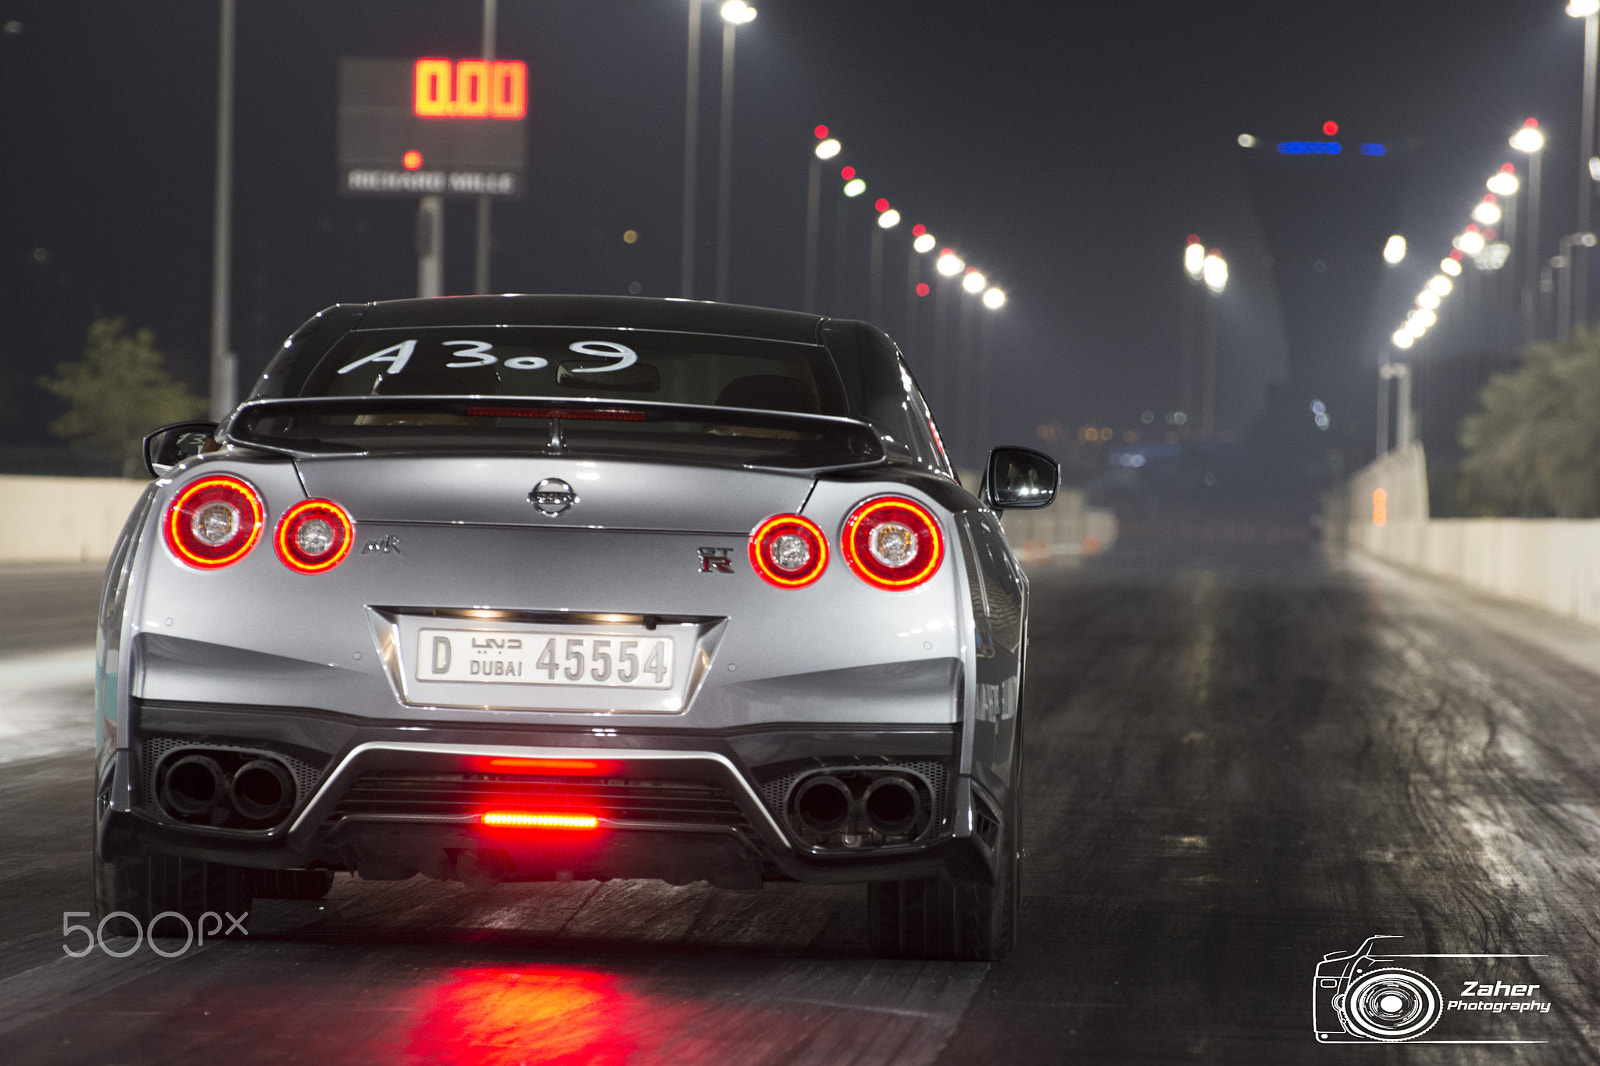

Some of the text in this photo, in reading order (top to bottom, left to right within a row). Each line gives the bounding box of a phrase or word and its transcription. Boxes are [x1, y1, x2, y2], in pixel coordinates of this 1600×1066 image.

[414, 57, 528, 120] 0.00
[449, 172, 515, 194] MILLE
[471, 637, 523, 655] دبي
[431, 636, 668, 684] D 45554
[469, 660, 523, 677] DUBAI
